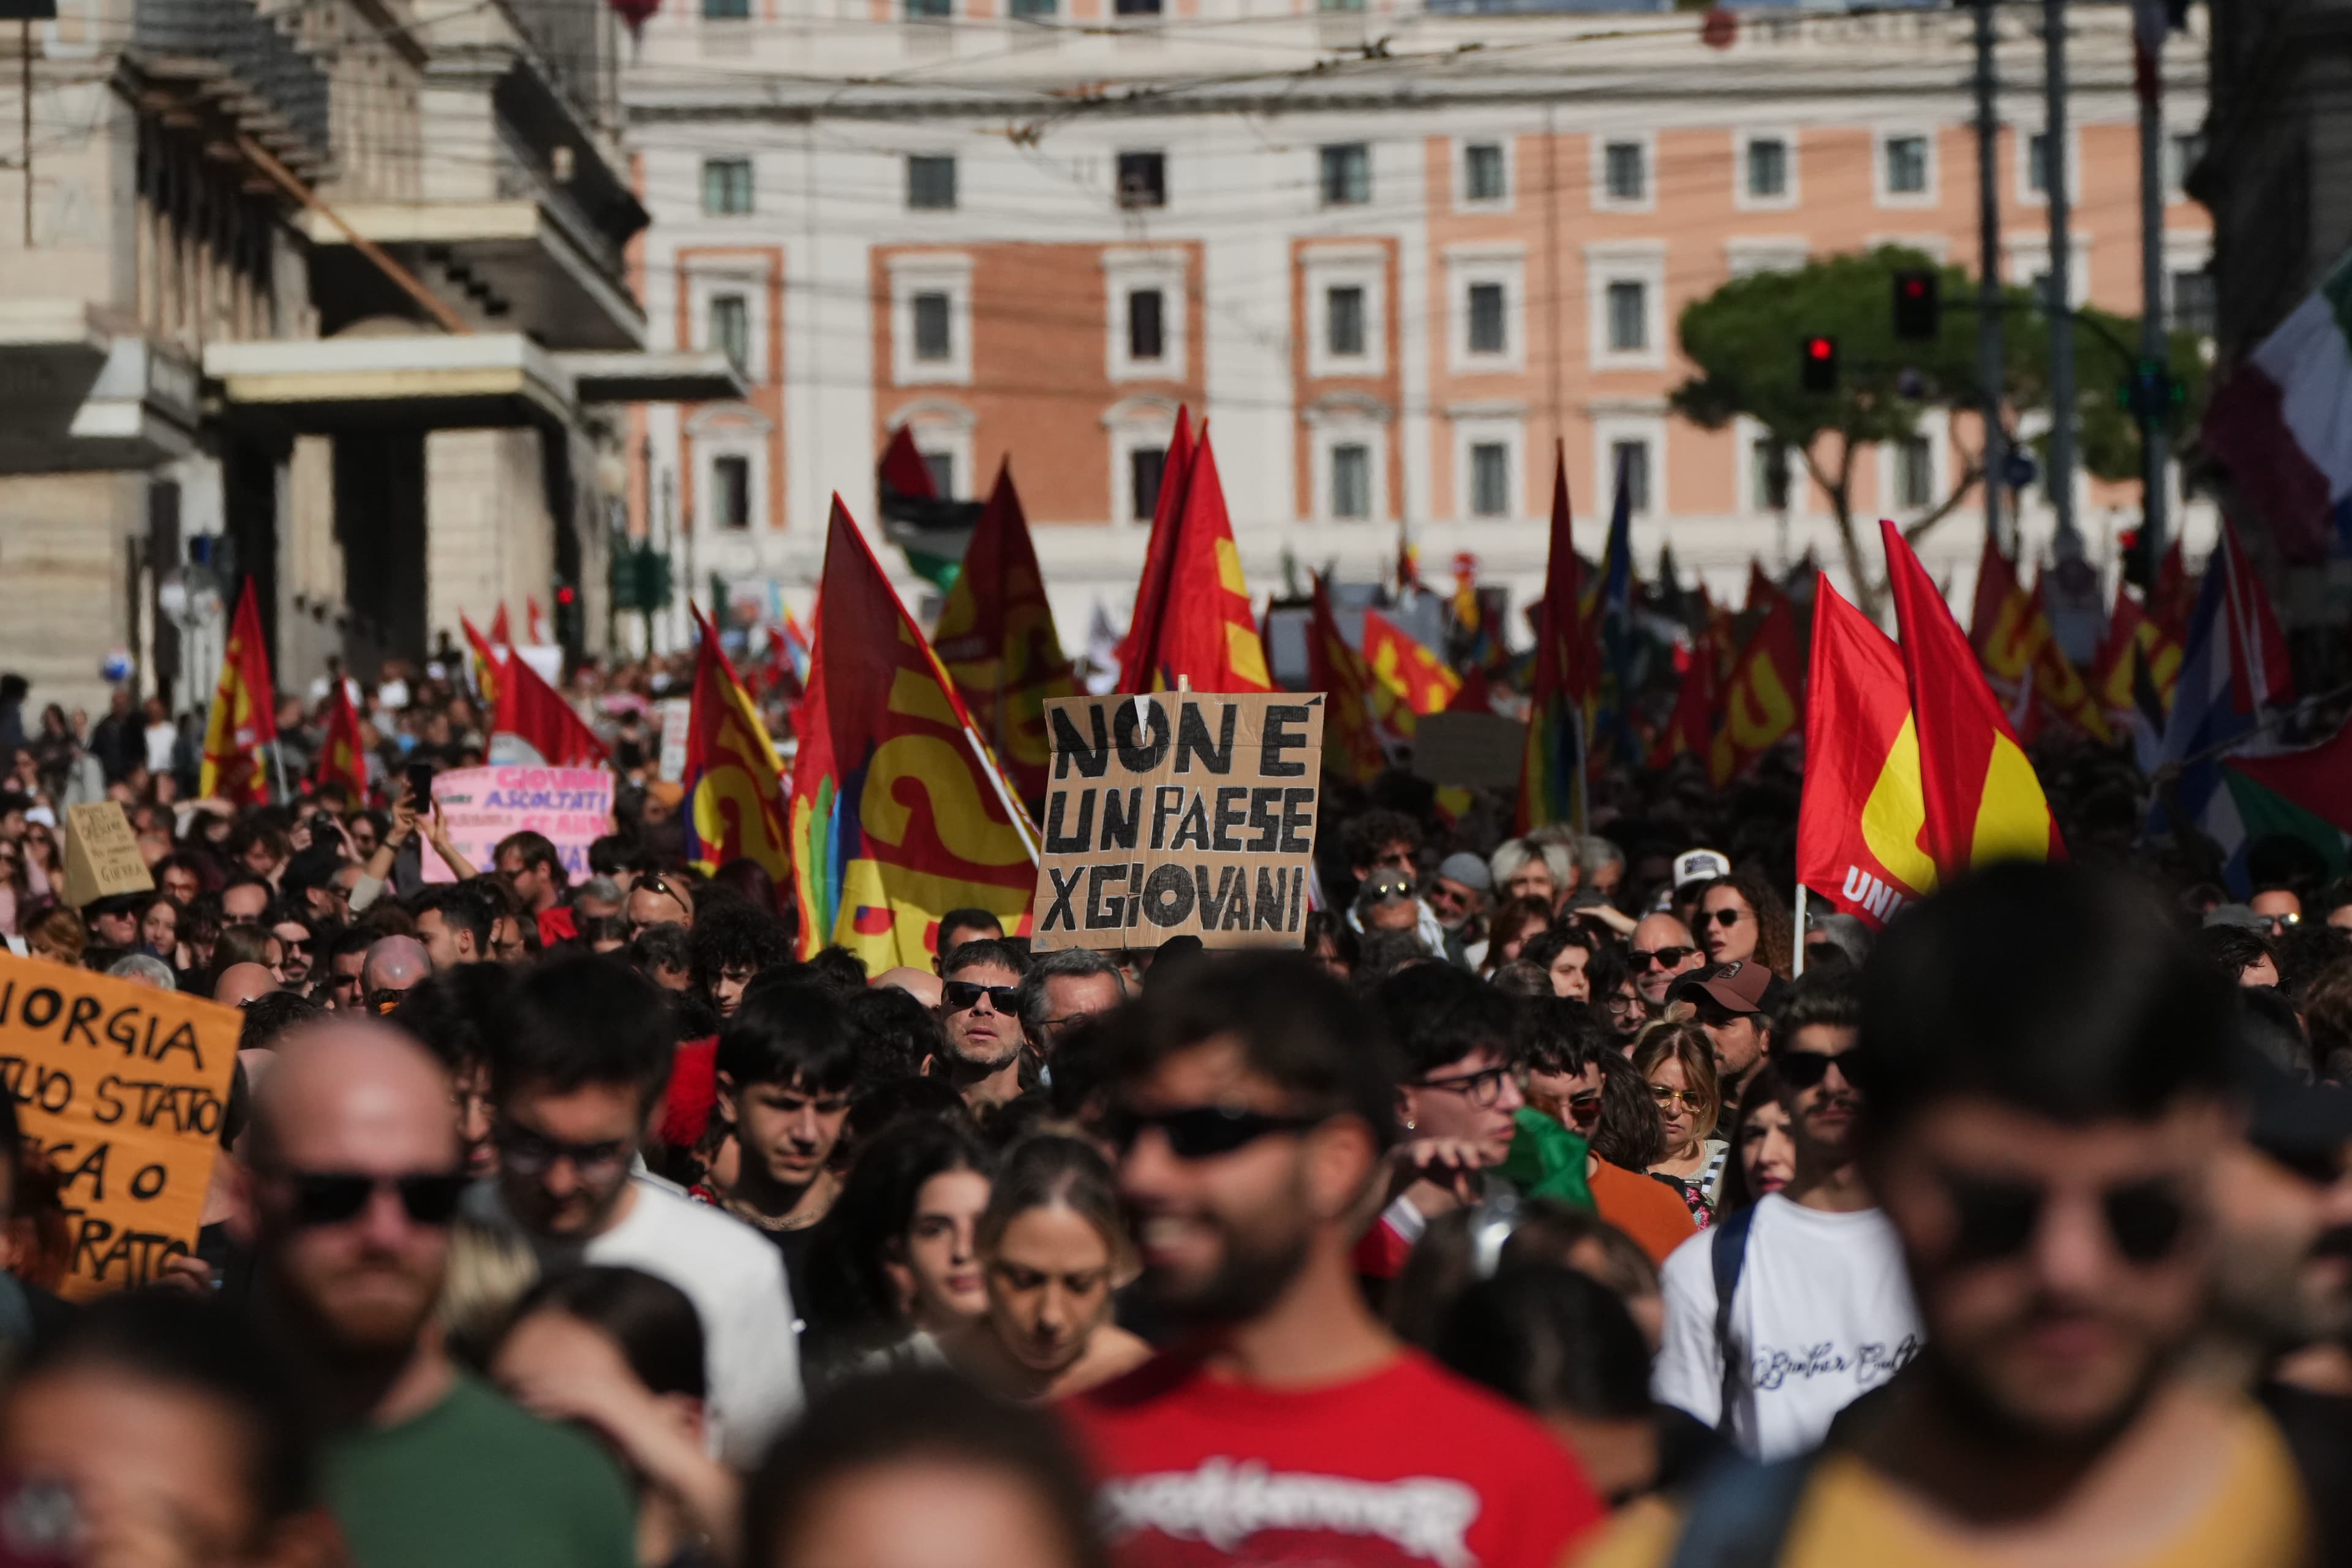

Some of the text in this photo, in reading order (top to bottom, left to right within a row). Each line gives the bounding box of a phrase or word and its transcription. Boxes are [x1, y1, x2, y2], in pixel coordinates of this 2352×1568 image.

[1050, 698, 1237, 780] NON
[1045, 785, 1316, 854] UN PAESE
[1842, 864, 1913, 925] UNI
[0, 982, 203, 1071] IORGIA
[94, 1076, 222, 1134] STATO
[130, 1163, 168, 1200] O
